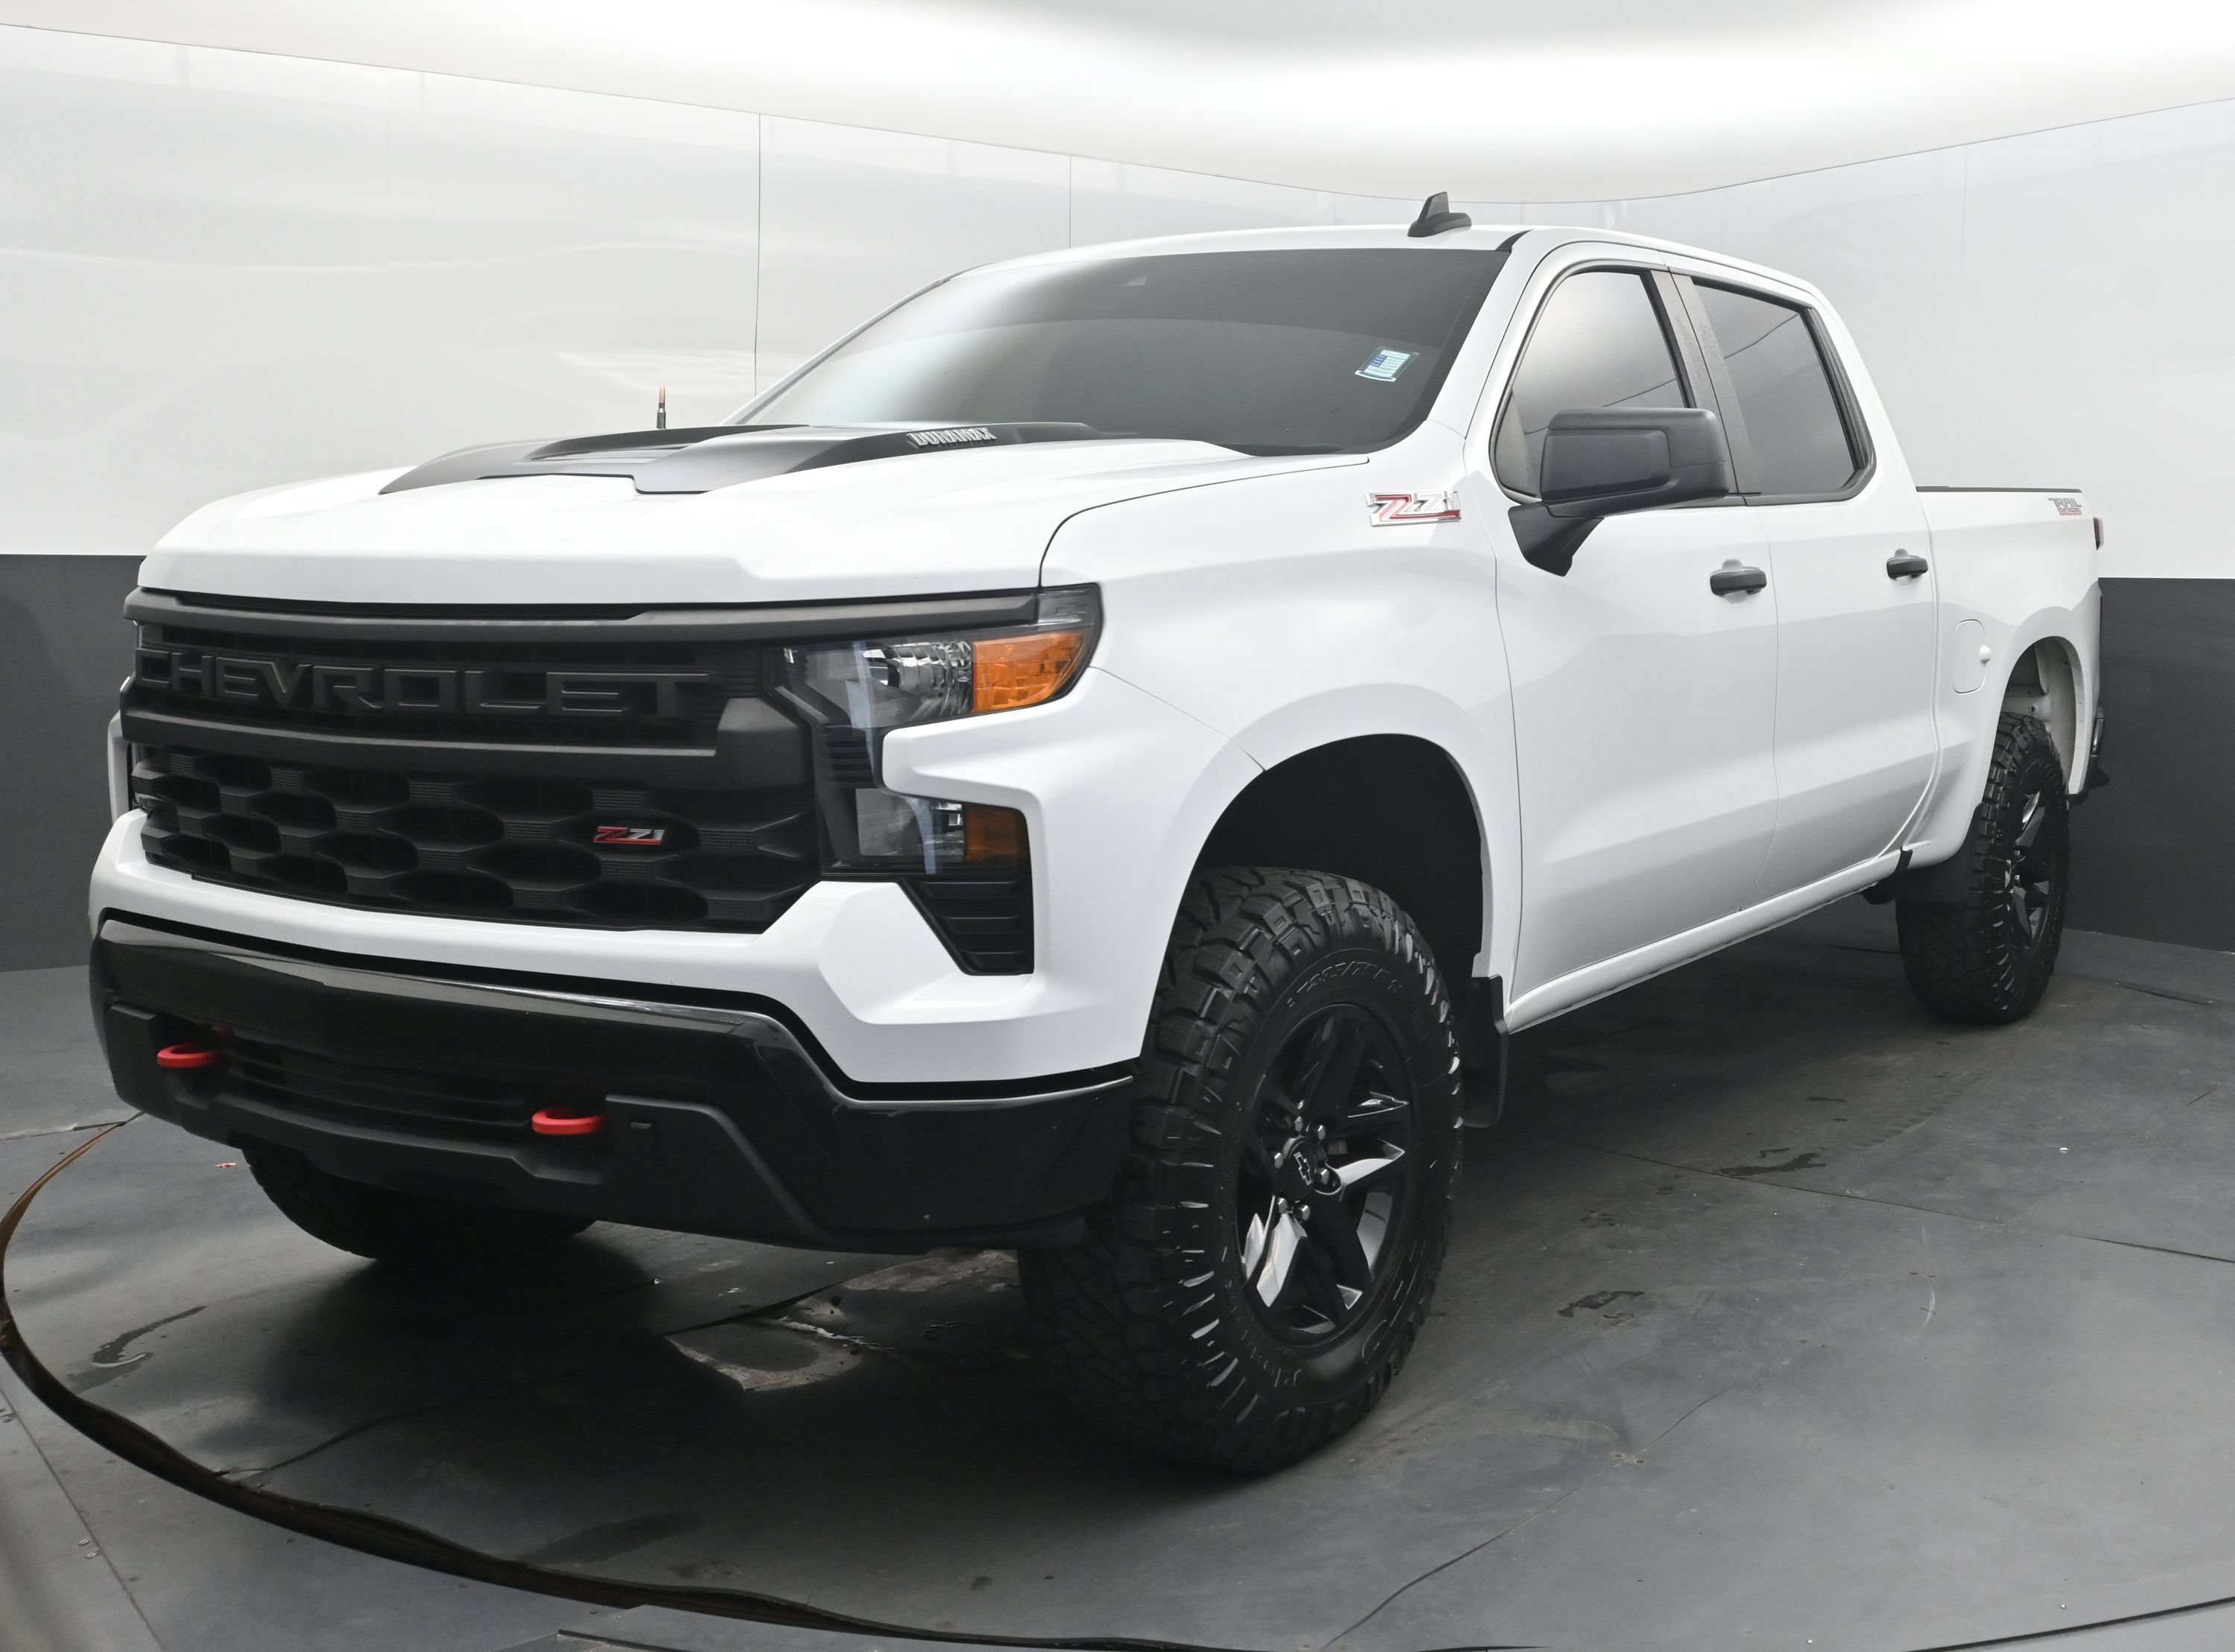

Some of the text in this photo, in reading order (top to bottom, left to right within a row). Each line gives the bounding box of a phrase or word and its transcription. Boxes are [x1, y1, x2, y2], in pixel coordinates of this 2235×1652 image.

[906, 428, 998, 446] DURAMAX
[1365, 491, 1462, 527] Z71
[2047, 498, 2082, 508] TRAIL
[2057, 507, 2082, 515] BOSS
[136, 646, 717, 716] CHEVROLET
[593, 826, 665, 845] Z71
